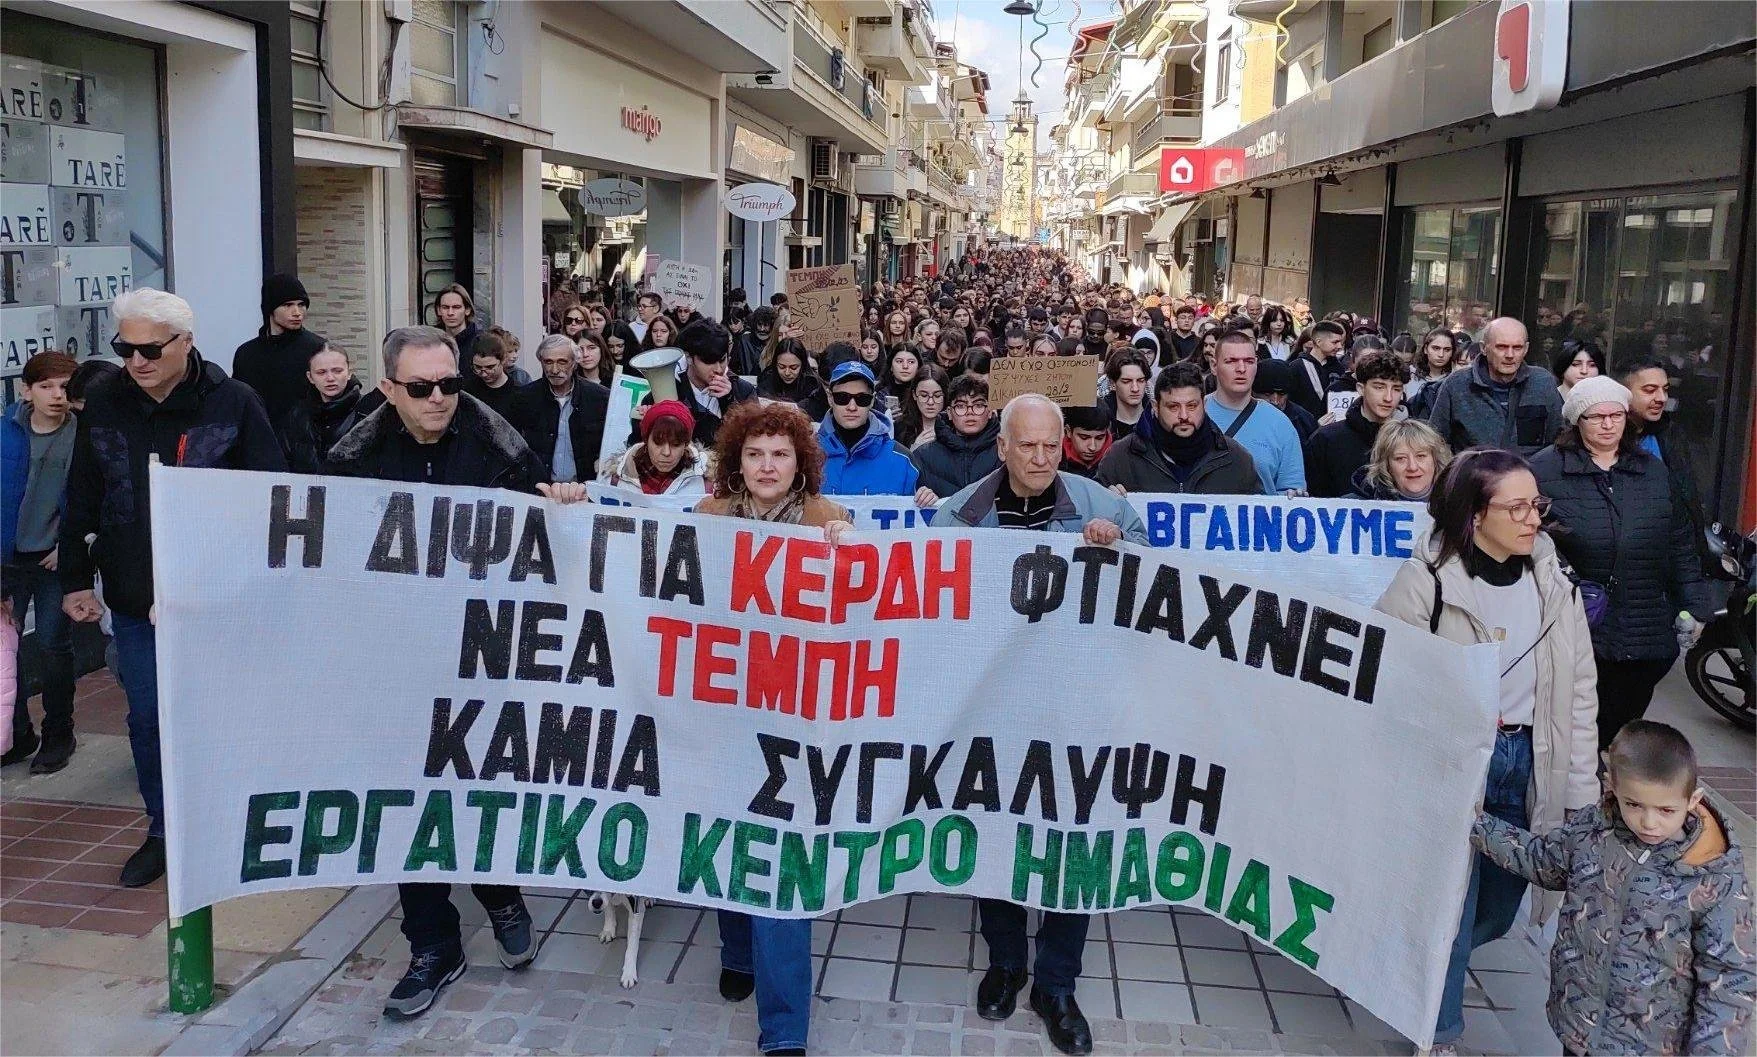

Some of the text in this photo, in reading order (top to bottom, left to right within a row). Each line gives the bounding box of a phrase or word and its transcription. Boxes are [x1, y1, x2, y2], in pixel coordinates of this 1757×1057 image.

[730, 193, 785, 215] Triumph
[268, 485, 1387, 704] Η ΔΙΨΑ ΓΙΑ ΚΕΡΔΗ ΦΤΙΑΧΝΕΙ
[1147, 501, 1414, 559] ΒΓΑΙΝΟΥΜΕ
[459, 599, 899, 721] ΝΕΑ ΤΕΜΠΗ
[423, 698, 1227, 836] ΚΑΜΙΑ ΣΥΓΚΑΛΥΨΗ
[240, 789, 1335, 970] ΕΡΓΑΤΙΚΟ ΚΕΝΤΡΟ ΗΜΑΘΙΑΣ
